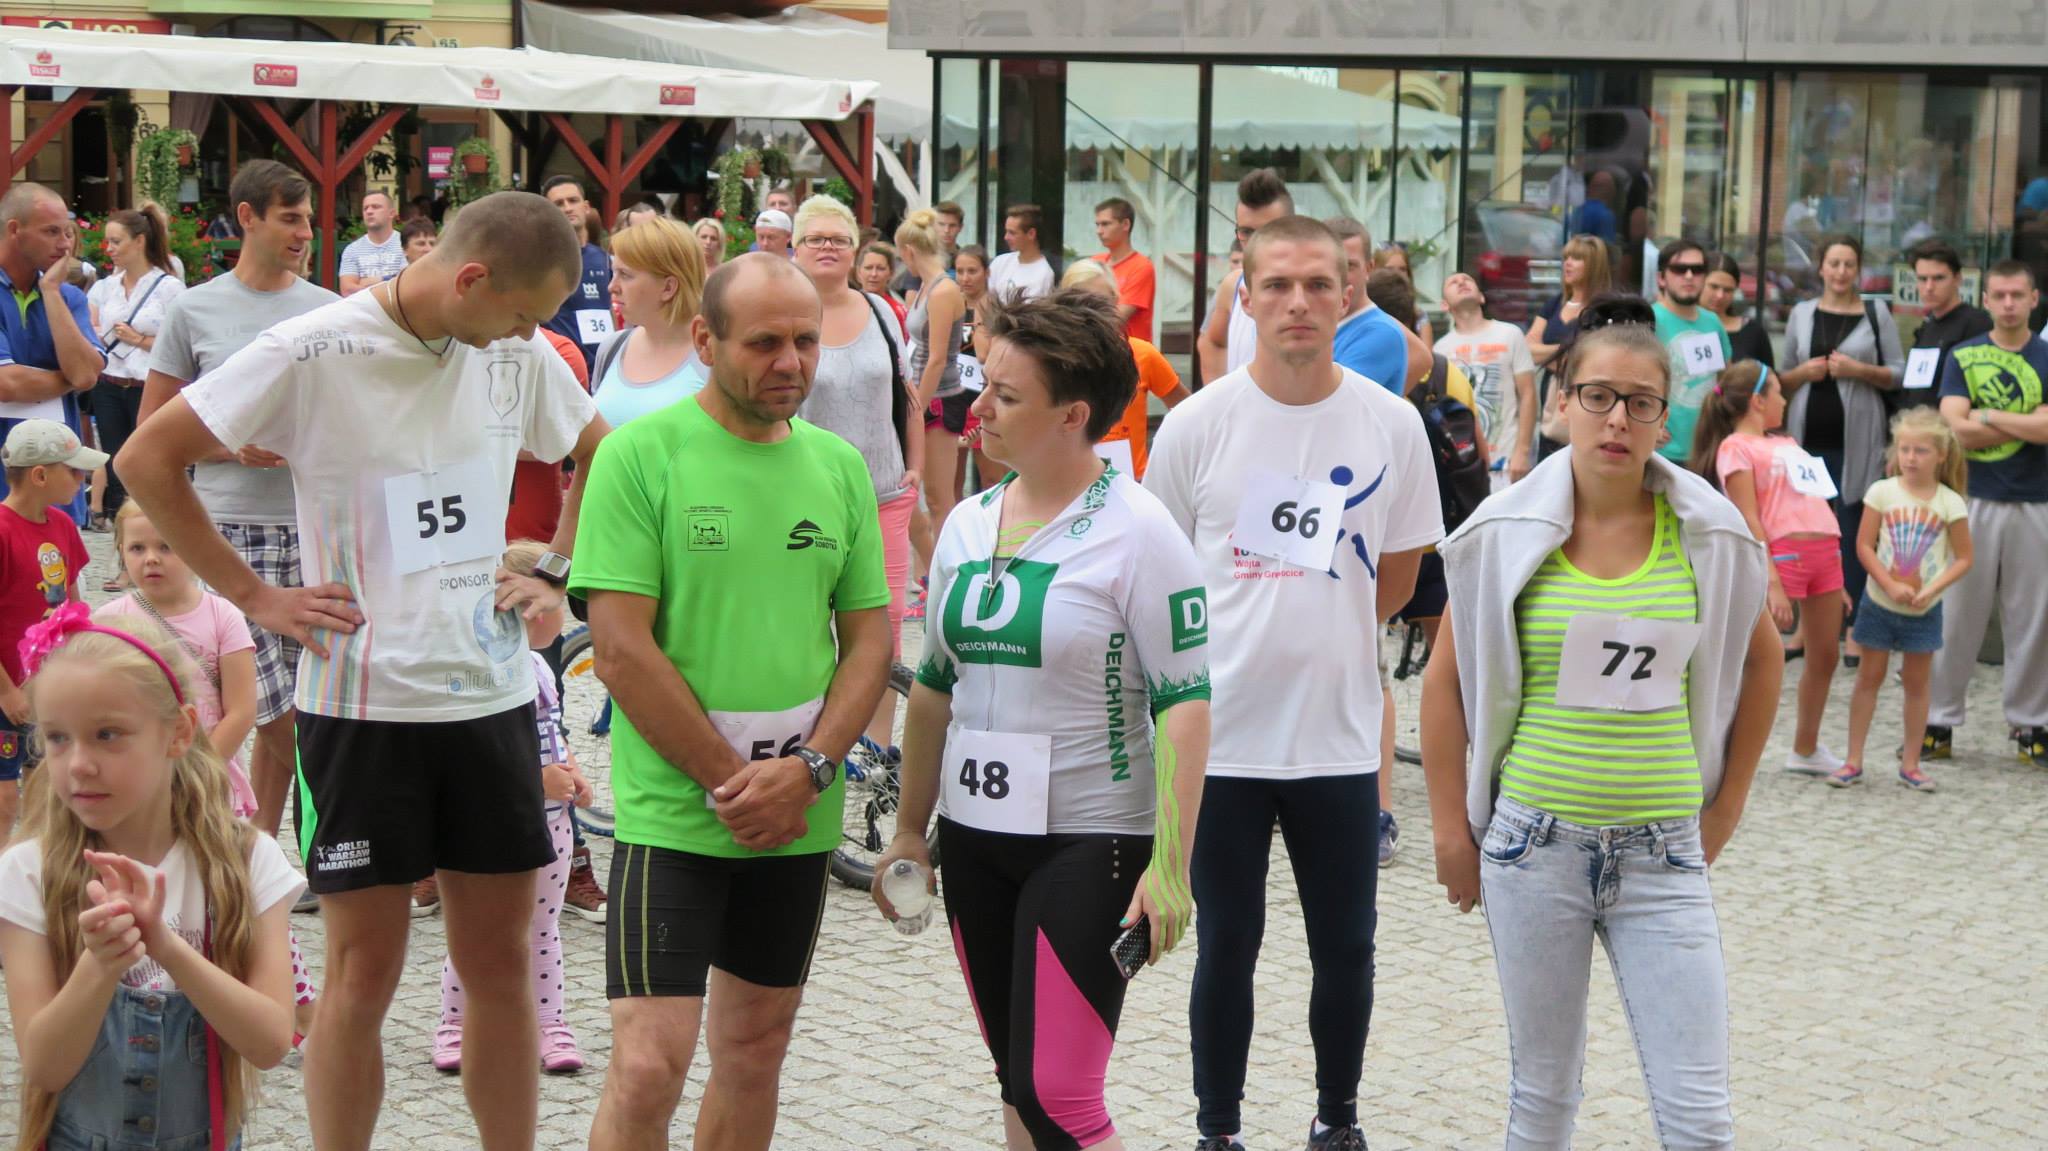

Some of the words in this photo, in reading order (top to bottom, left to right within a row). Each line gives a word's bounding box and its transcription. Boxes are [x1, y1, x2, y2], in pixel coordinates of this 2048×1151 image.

[591, 319, 606, 332] 36
[296, 341, 329, 362] JP
[1694, 345, 1713, 361] 58
[416, 494, 467, 539] 55
[1271, 500, 1321, 539] 66
[440, 573, 490, 590] SPONSOR
[1182, 597, 1206, 630] D
[956, 641, 1027, 656] DEICHMANN
[1600, 640, 1657, 680] 72
[1103, 632, 1132, 782] DEICHMANN
[959, 757, 1011, 800] 48
[328, 849, 371, 862] WARSAW
[336, 840, 370, 852] ORLEN
[318, 857, 371, 871] MARATHON
